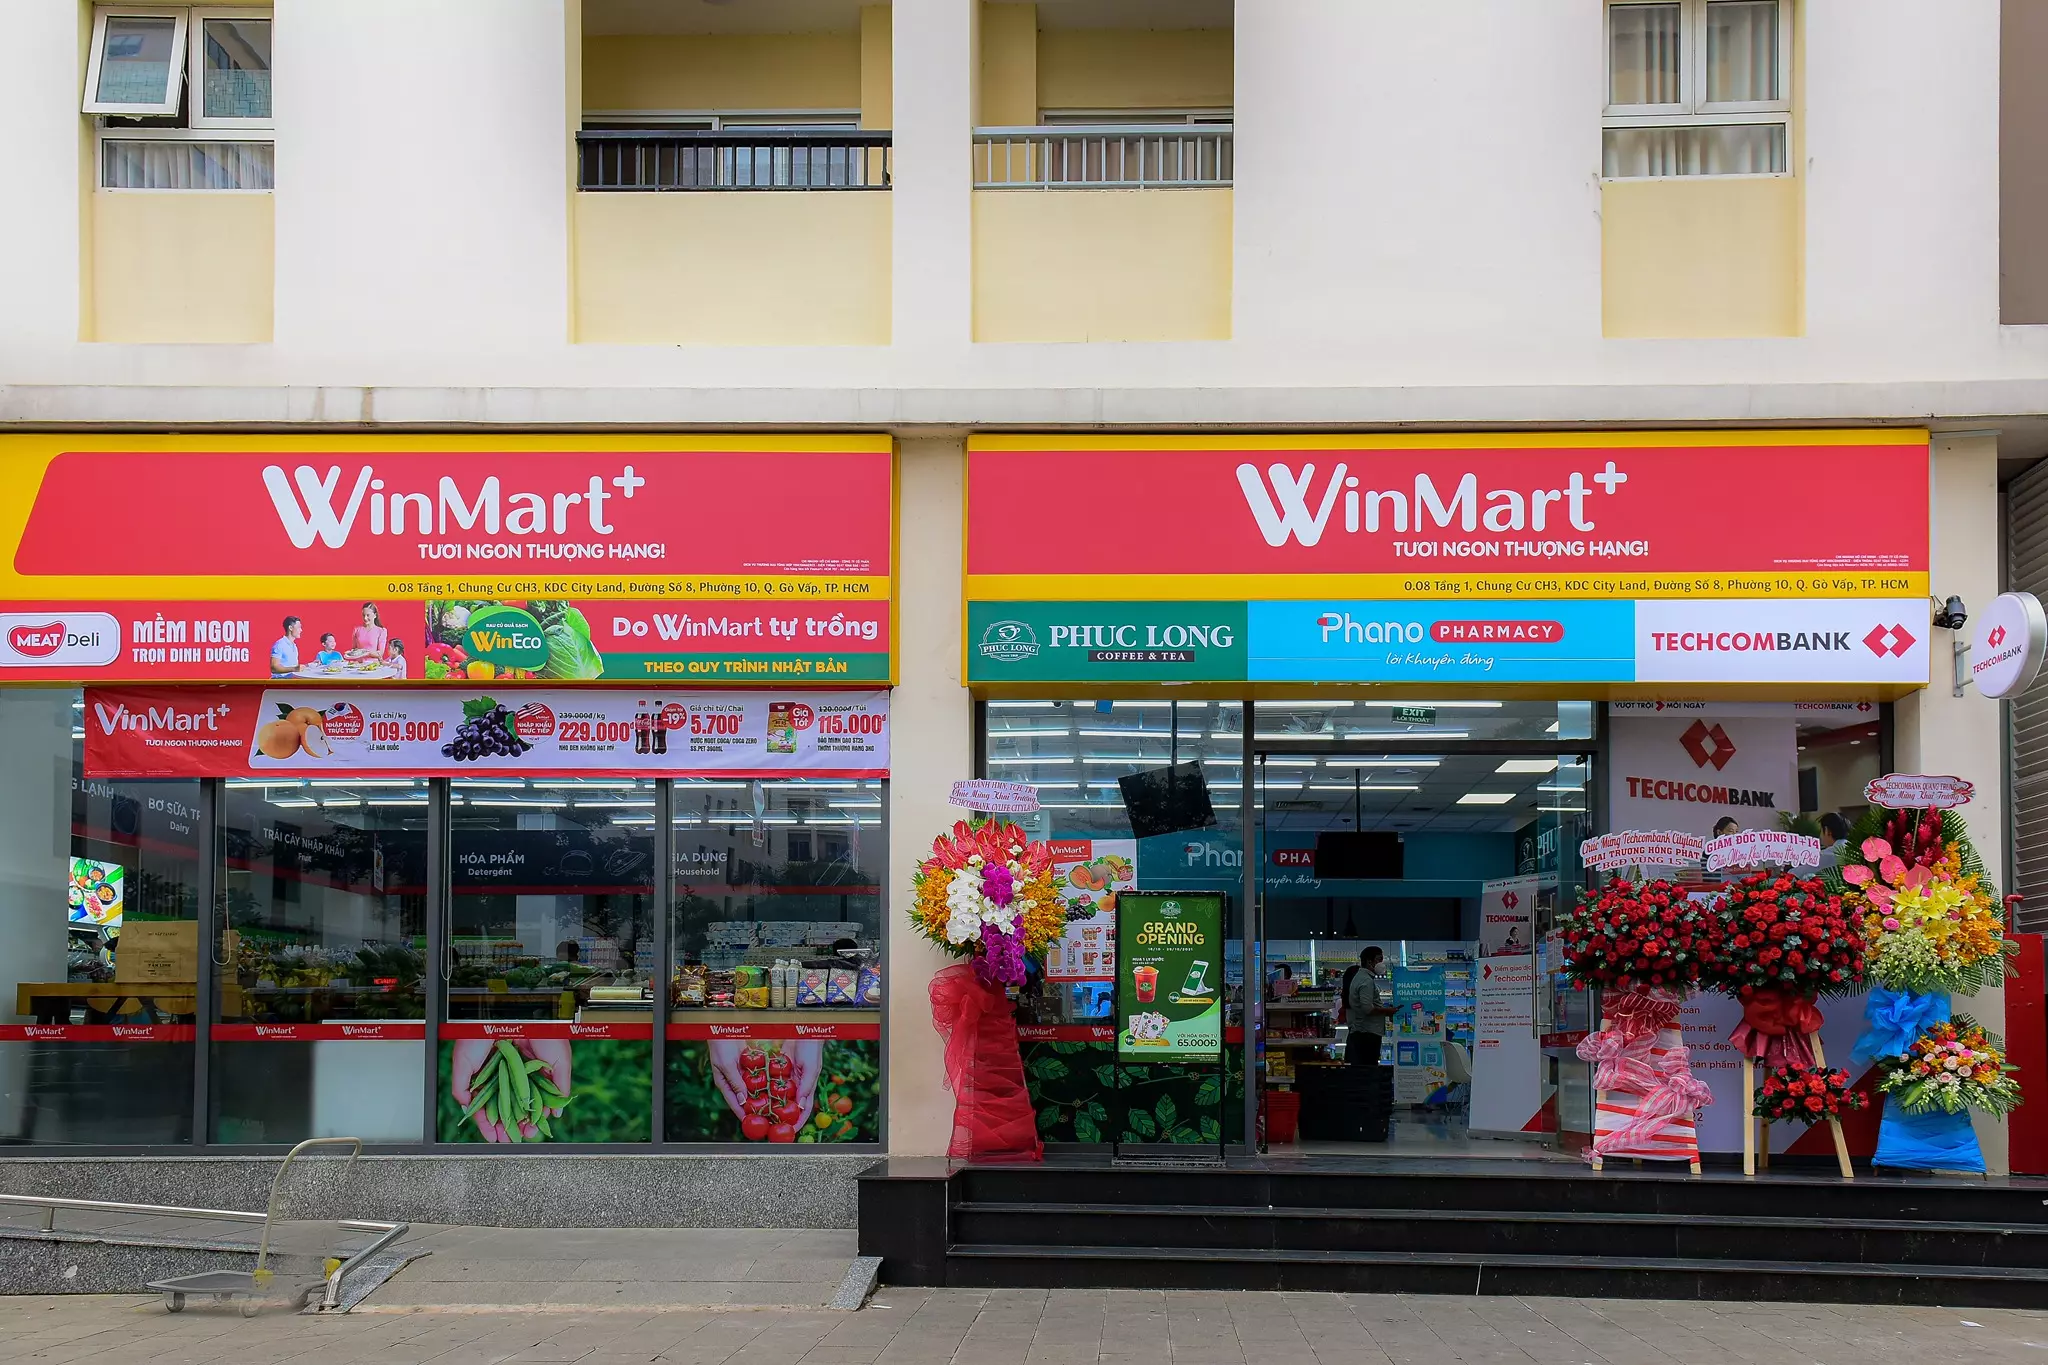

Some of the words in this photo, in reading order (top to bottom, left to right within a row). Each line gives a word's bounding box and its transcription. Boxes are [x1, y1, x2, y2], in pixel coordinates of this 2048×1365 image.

[418, 543, 462, 559] TƯƠI
[467, 543, 523, 559] NGON
[527, 543, 604, 562] THƯỢNG
[609, 543, 666, 561] HẠNG!
[1393, 540, 1437, 557] TƯƠI
[1443, 541, 1499, 557] NGON
[1504, 540, 1584, 560] THƯỢNG
[1589, 540, 1649, 559] HẠNG!
[388, 582, 415, 594] 0.08
[417, 580, 443, 596] Tầng
[446, 582, 455, 595] 1,
[458, 581, 494, 596] Chung
[497, 581, 512, 594] Cư
[515, 582, 541, 595] CH3,
[544, 582, 569, 594] KDC
[571, 581, 594, 597] City
[596, 581, 626, 596] Land,
[629, 581, 666, 597] Đường
[668, 578, 684, 593] Số
[686, 582, 696, 595] 8,
[699, 581, 742, 597] Phường
[744, 582, 760, 595] 10,
[764, 581, 776, 595] Q.
[779, 580, 796, 594] Gò
[798, 579, 822, 597] Vấp,
[824, 582, 840, 593] TP.
[843, 581, 870, 593] HCM
[1404, 580, 1431, 592] 0.08
[1434, 578, 1460, 594] Tầng
[1464, 580, 1472, 593] 1,
[1476, 579, 1513, 594] Chung
[1516, 579, 1531, 591] Cư
[1534, 579, 1561, 593] CH3,
[1565, 579, 1589, 591] KDC
[1593, 579, 1617, 594] City
[1619, 579, 1650, 593] Land,
[1654, 579, 1692, 594] Đường
[1695, 576, 1710, 591] Số
[1713, 579, 1724, 592] 8,
[1727, 578, 1771, 594] Phường
[1774, 579, 1792, 592] 10,
[1796, 579, 1809, 593] Q.
[1812, 578, 1828, 591] Gò
[1832, 577, 1858, 594] Vấp,
[1861, 579, 1877, 590] TP.
[1880, 579, 1909, 590] HCM
[132, 612, 188, 643] MỀM
[194, 620, 250, 644] NGON
[613, 617, 649, 637] Do
[653, 613, 763, 641] WinMart
[769, 617, 798, 641] tự
[806, 611, 878, 641] trồng
[1317, 612, 1424, 643] Phano
[1440, 625, 1554, 639] PHARMACY
[16, 633, 61, 648] MEAT
[67, 631, 100, 647] Deli
[470, 630, 542, 652] WinEco
[1048, 625, 1138, 648] PHUC
[1143, 625, 1234, 648] LONG
[1651, 631, 1851, 652] TECHCOMBANK
[132, 647, 166, 666] TRỌN
[170, 649, 201, 662] DINH
[203, 645, 250, 662] DƯỠNG
[983, 644, 1009, 653] PHUC
[1011, 644, 1036, 653] LONG
[1096, 651, 1145, 661] COFFEE
[1148, 651, 1157, 661] &
[1162, 651, 1186, 661] TEA
[644, 660, 685, 673] THEO
[689, 660, 721, 674] QUY
[723, 657, 769, 673] TRÌNH
[772, 658, 812, 675] NHẬT
[816, 656, 847, 673] BẢN
[1460, 652, 1495, 671] đúng
[1973, 645, 2022, 674] TECHCOMBANK
[793, 707, 809, 717] Giá
[1402, 708, 1426, 717] EXIT
[794, 717, 809, 727] Tốt
[164, 739, 187, 747] NGON
[1626, 776, 1776, 808] TECHCOMBANK
[148, 797, 165, 812] BƠ
[166, 800, 188, 819] SỮA
[169, 820, 190, 835] Dairy
[459, 851, 487, 865] HÓA
[489, 849, 525, 864] PHẨM
[692, 852, 728, 864] DỤNG
[1585, 852, 1606, 865] KHAI
[468, 868, 513, 877] Detergent
[1143, 922, 1198, 934] GRAND
[1136, 933, 1205, 945] OPENING
